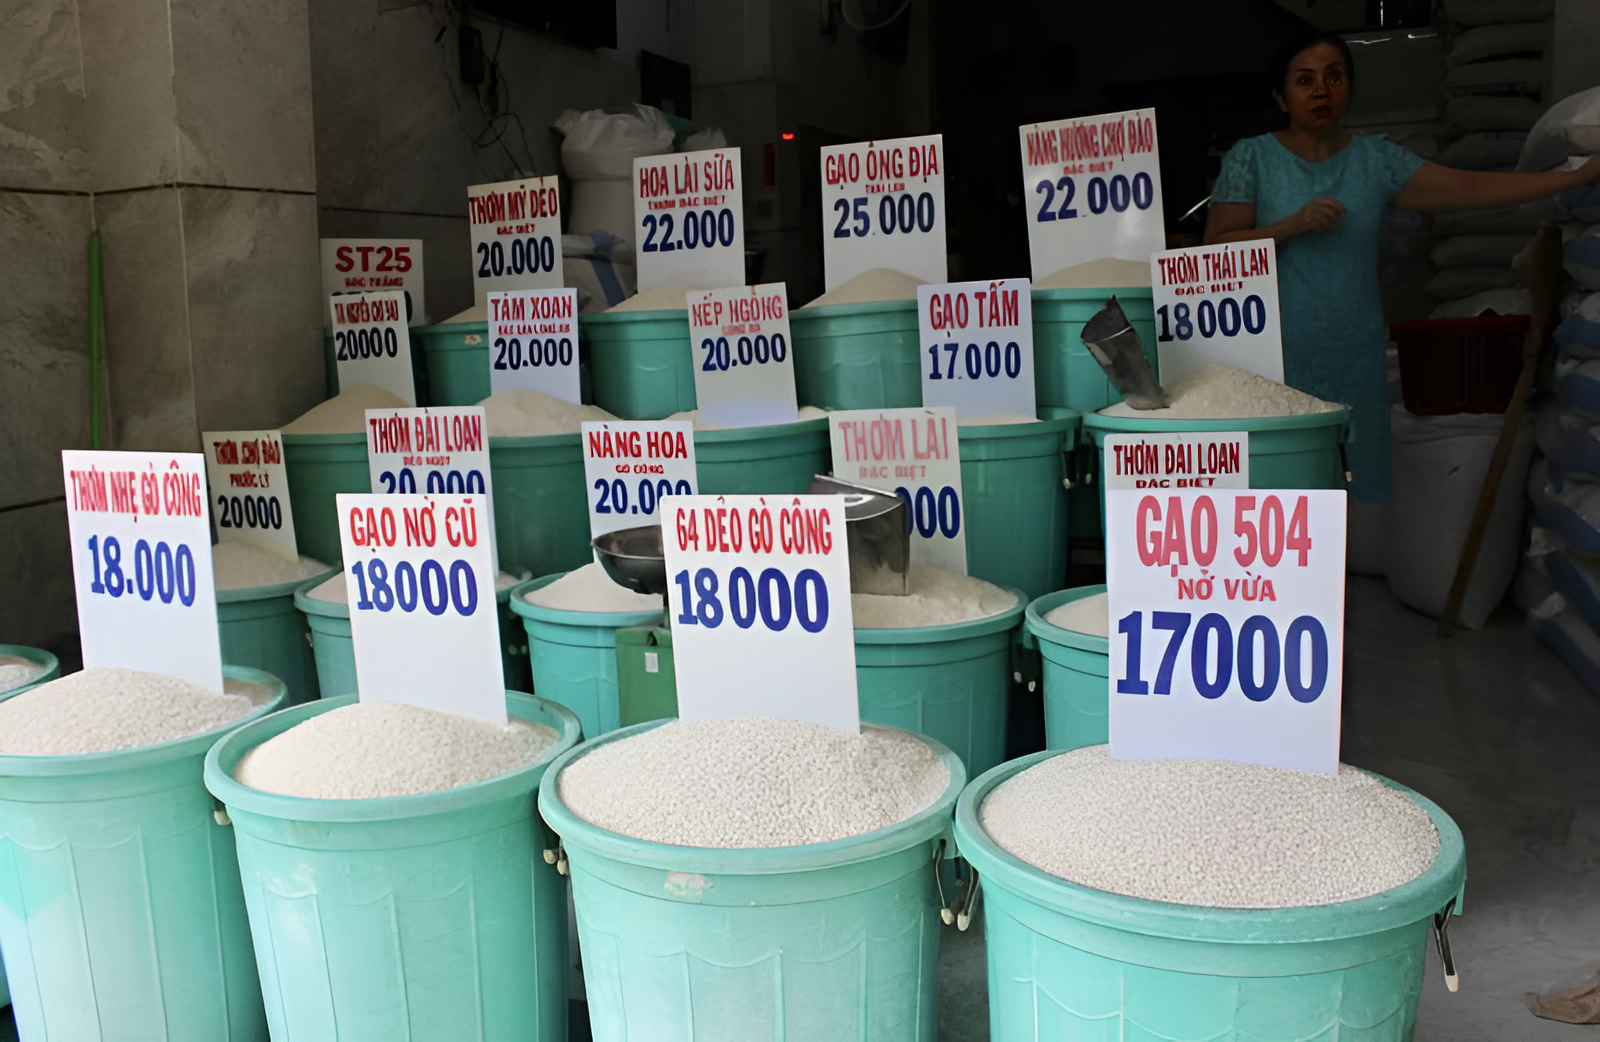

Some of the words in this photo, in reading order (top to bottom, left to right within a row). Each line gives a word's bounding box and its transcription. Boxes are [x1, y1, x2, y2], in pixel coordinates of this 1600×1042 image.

[640, 167, 669, 198] HOA
[674, 156, 698, 194] LÀI
[704, 153, 734, 191] SỮA
[826, 152, 860, 190] GẠO
[866, 141, 904, 181] ÔNG
[909, 144, 939, 184] ĐỊA
[642, 208, 735, 252] 22.000
[335, 246, 412, 273] ST25
[477, 236, 555, 278] 20.000
[1158, 252, 1200, 286] THƠM
[1202, 245, 1237, 282] THÁI
[1240, 247, 1269, 277] LAN
[530, 295, 572, 320] XOAN
[930, 292, 969, 338] GẠO
[973, 280, 1019, 328] TẤM
[336, 327, 398, 361] 20000
[494, 337, 573, 371] 20.000
[701, 333, 786, 372] 20.000
[369, 412, 412, 454] THƠM
[414, 407, 440, 453] ĐÀI
[443, 414, 482, 453] LOAN
[588, 424, 642, 458] NÀNG
[646, 430, 688, 459] HOA
[838, 413, 905, 462] THƠM
[911, 409, 949, 460] LÀI
[1113, 439, 1159, 475] THƠM
[1197, 442, 1240, 475] LOAN
[70, 464, 109, 513] THƠM
[110, 471, 139, 524] NHẸ
[141, 461, 160, 516] GÒ
[163, 459, 202, 517] CÔNG
[217, 494, 283, 530] 20000
[350, 507, 397, 553] GẠO
[402, 495, 437, 548] NỞ
[445, 497, 478, 548] CŨ
[676, 507, 699, 552] 64
[703, 496, 743, 554] DẺO
[748, 496, 773, 554] GÒ
[779, 497, 833, 556] CÔNG
[1136, 495, 1218, 577] GẠO
[1234, 495, 1312, 567] 504
[88, 534, 196, 608] 18.000
[351, 558, 478, 617] 18000
[1177, 569, 1216, 600] NỞ
[1223, 571, 1277, 602] VỪA
[1116, 610, 1329, 704] 17000
